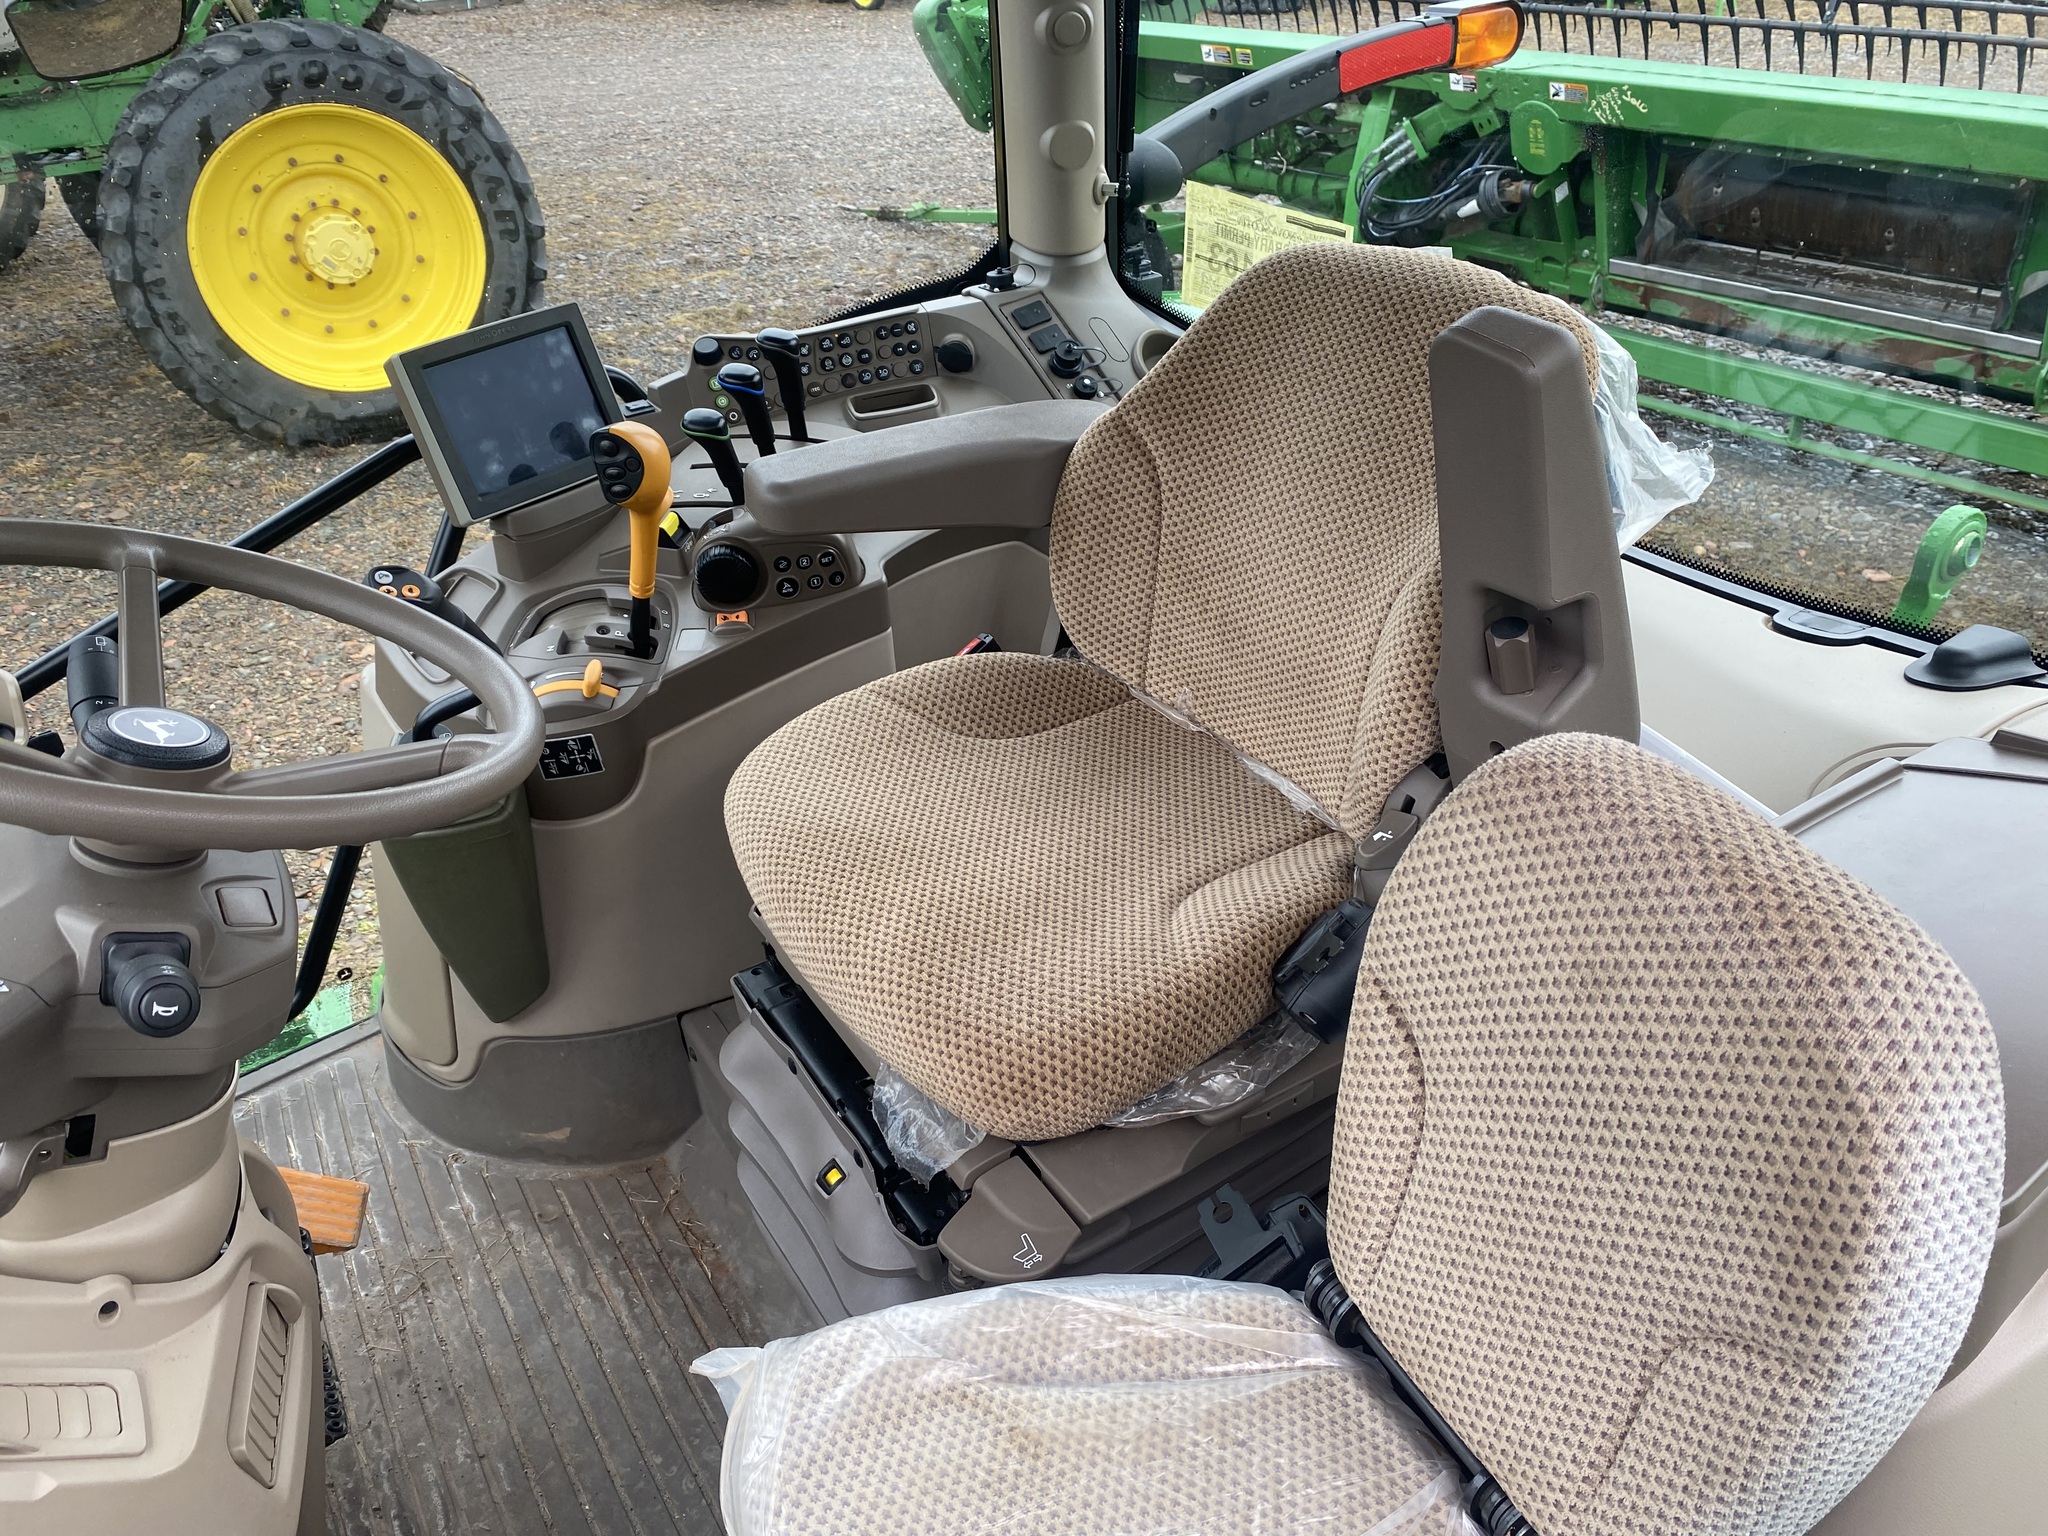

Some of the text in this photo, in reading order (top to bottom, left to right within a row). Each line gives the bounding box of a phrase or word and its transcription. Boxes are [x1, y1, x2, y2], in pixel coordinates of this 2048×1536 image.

[471, 325, 518, 343] JOHN DEERE
[801, 558, 808, 566] 2
